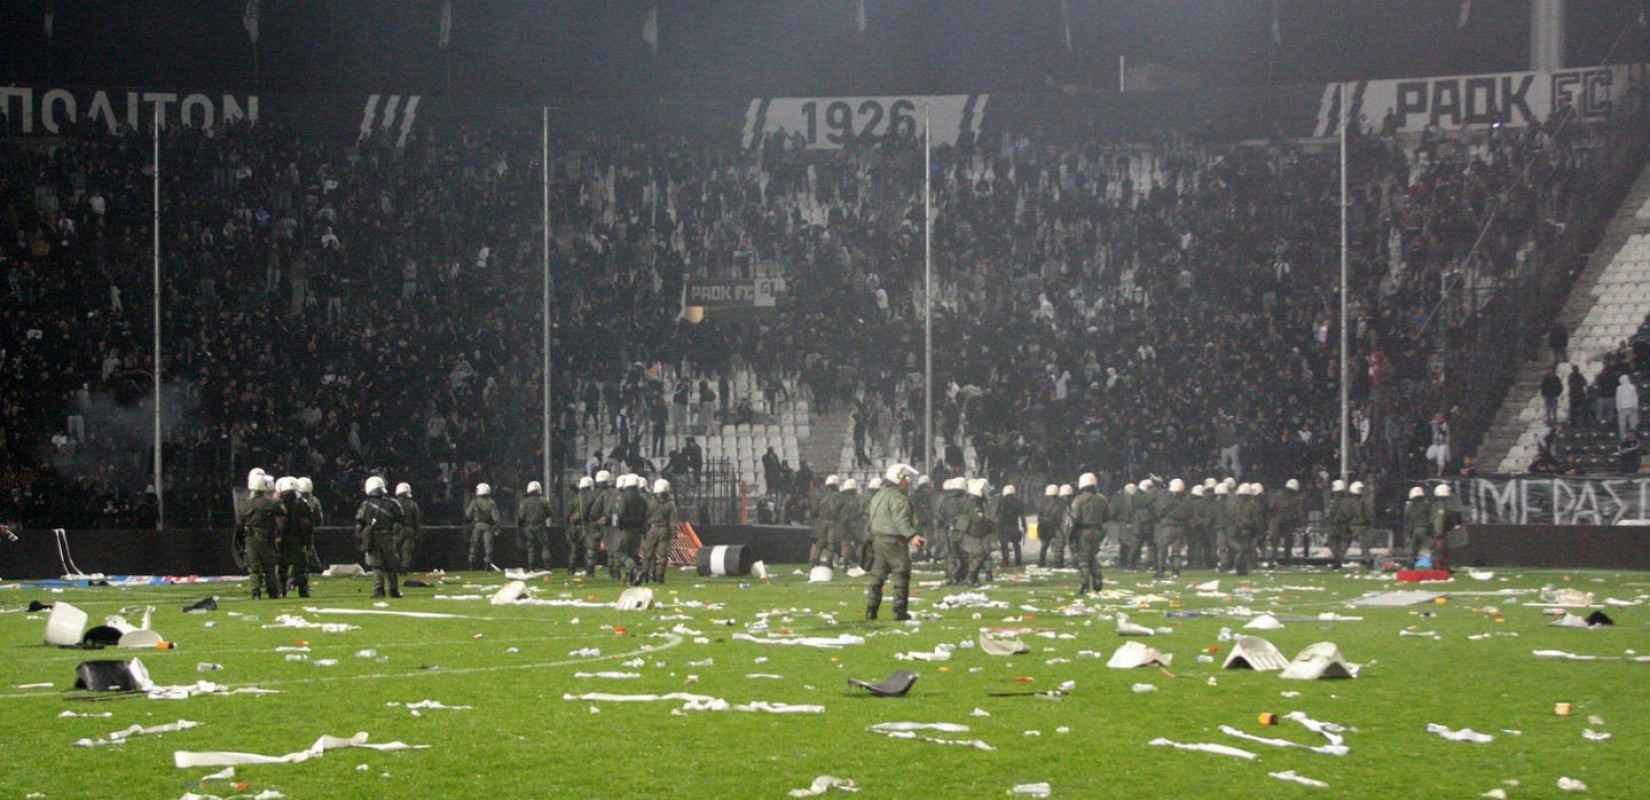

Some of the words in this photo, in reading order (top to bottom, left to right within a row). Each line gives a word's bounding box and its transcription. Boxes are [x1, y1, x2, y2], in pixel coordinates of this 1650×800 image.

[1396, 75, 1535, 127] PAOK
[1550, 68, 1612, 118] FC
[801, 99, 916, 146] 1926
[691, 285, 731, 301] PAOK
